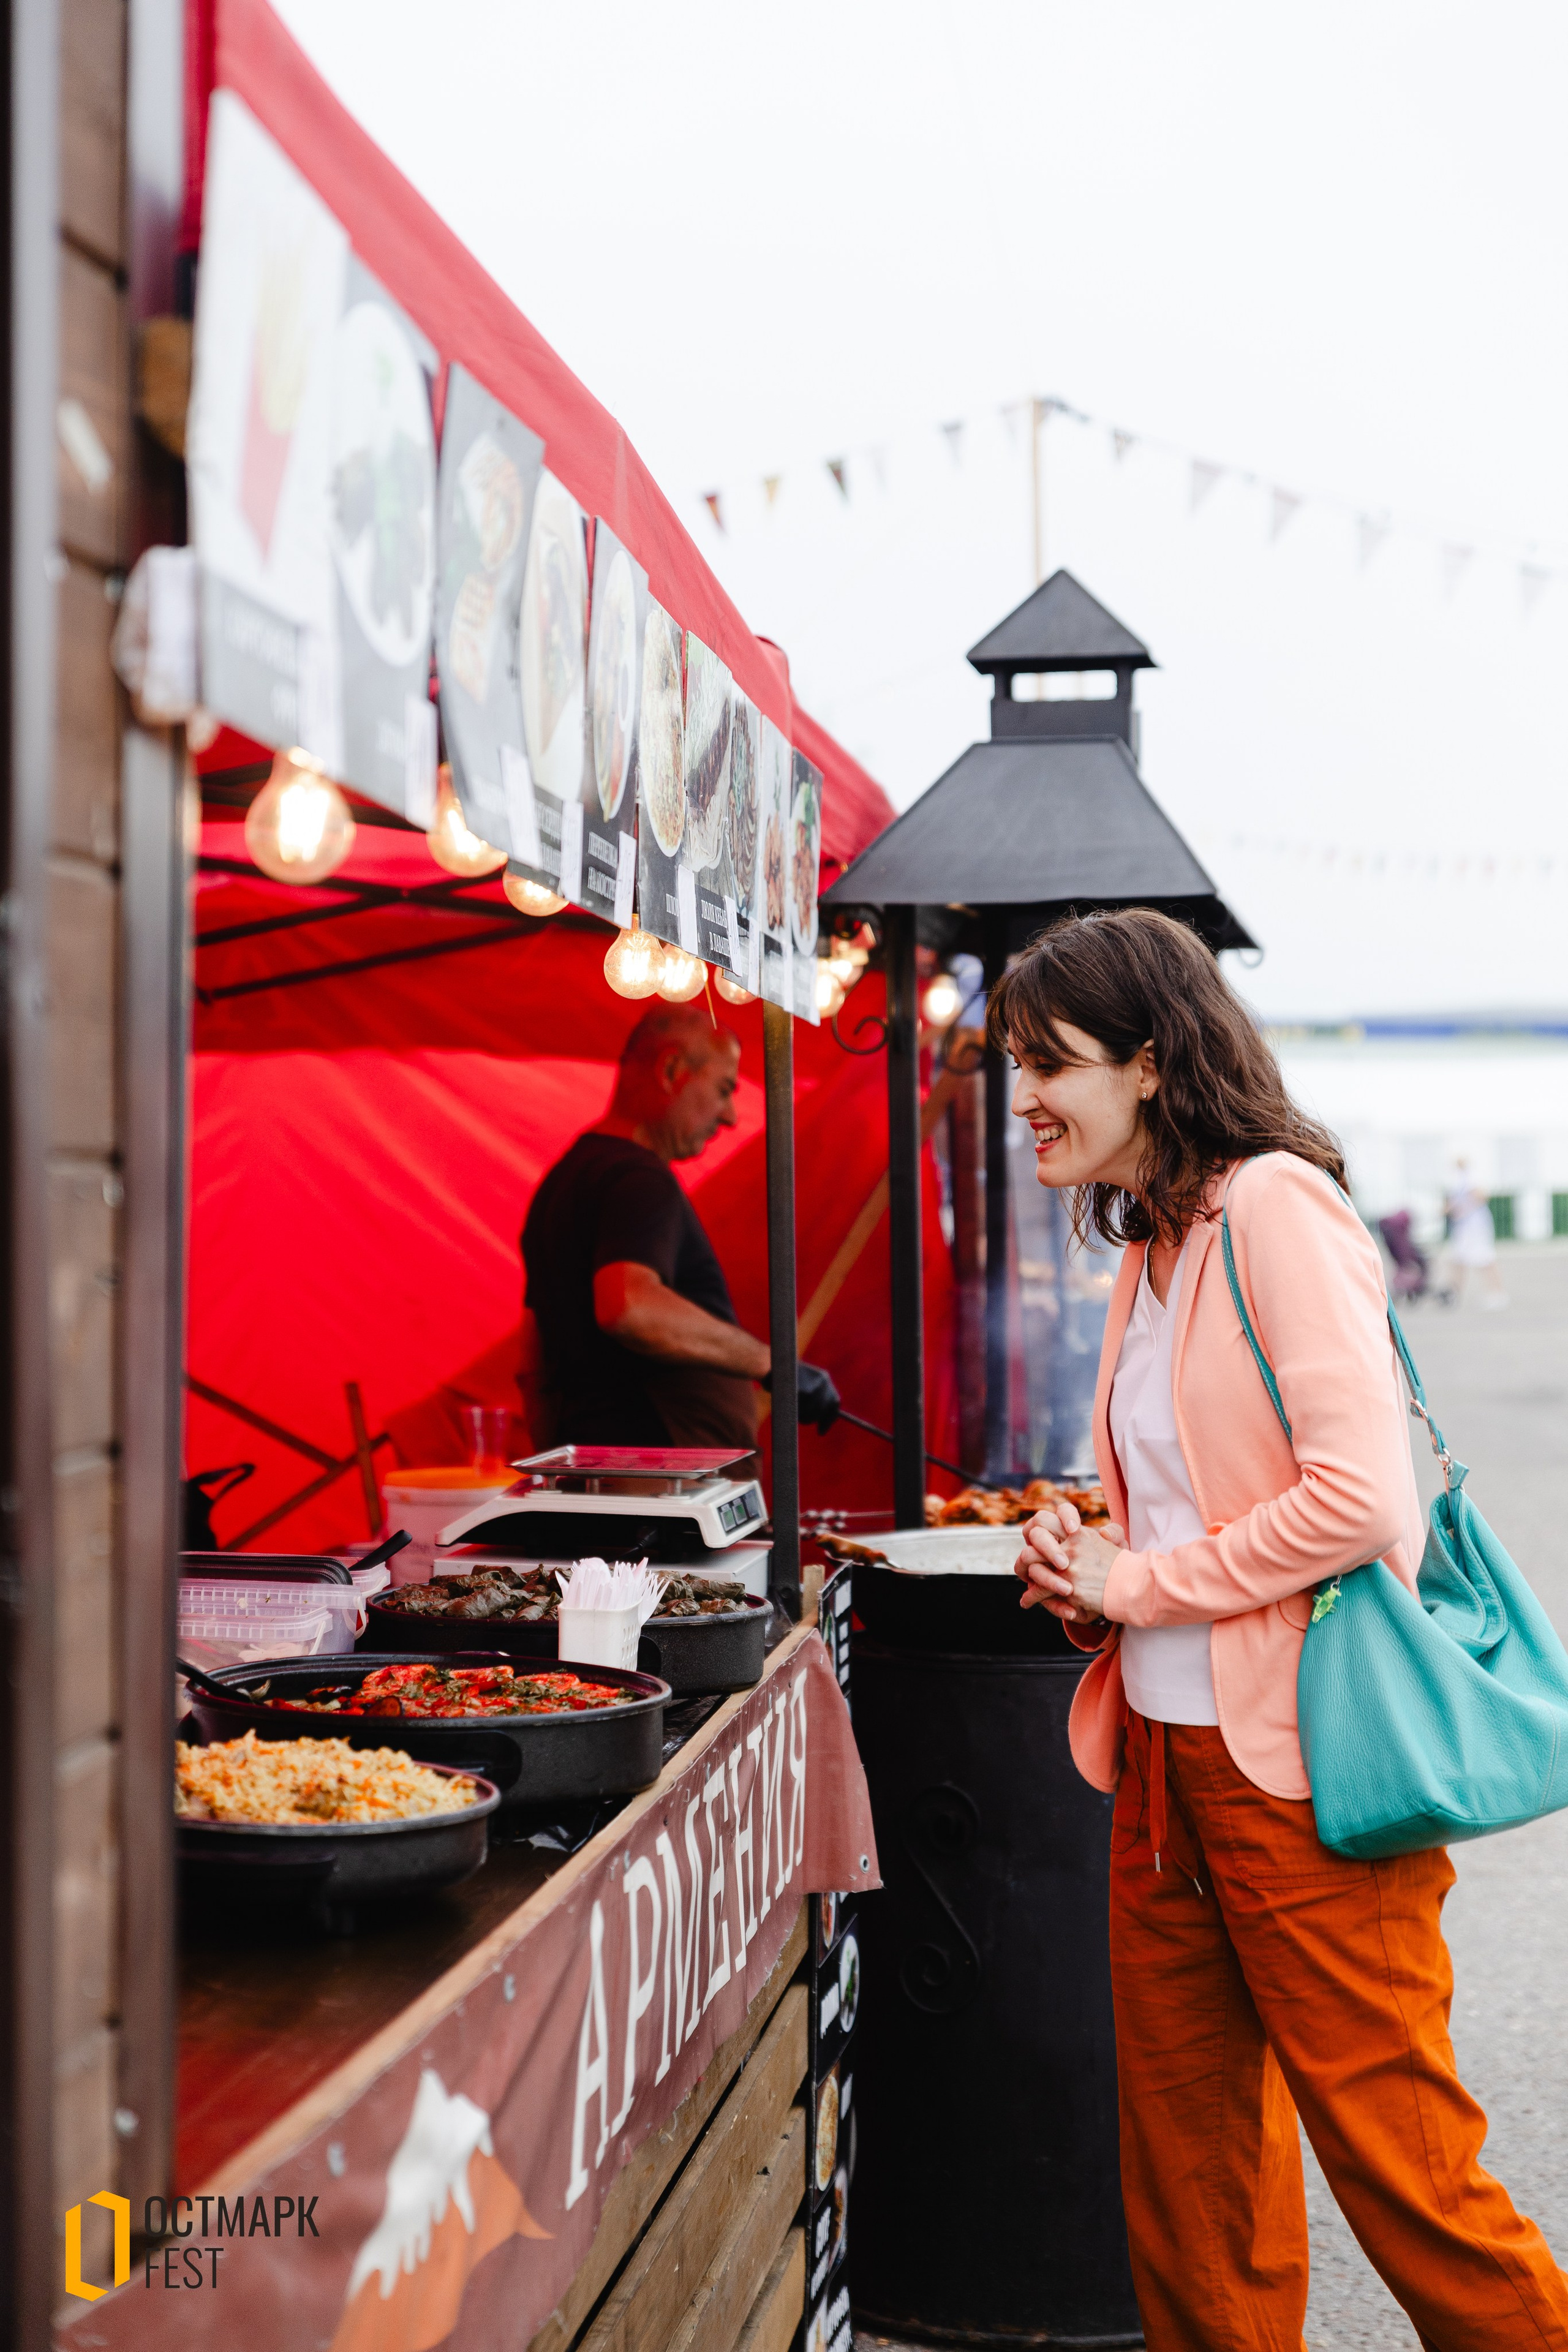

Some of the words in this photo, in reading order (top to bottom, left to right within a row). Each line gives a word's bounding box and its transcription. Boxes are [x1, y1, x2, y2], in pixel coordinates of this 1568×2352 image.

[701, 899, 715, 922] ЛЮЛЯ
[709, 931, 714, 950] В
[565, 1666, 809, 2211] АРМЕНИЯ
